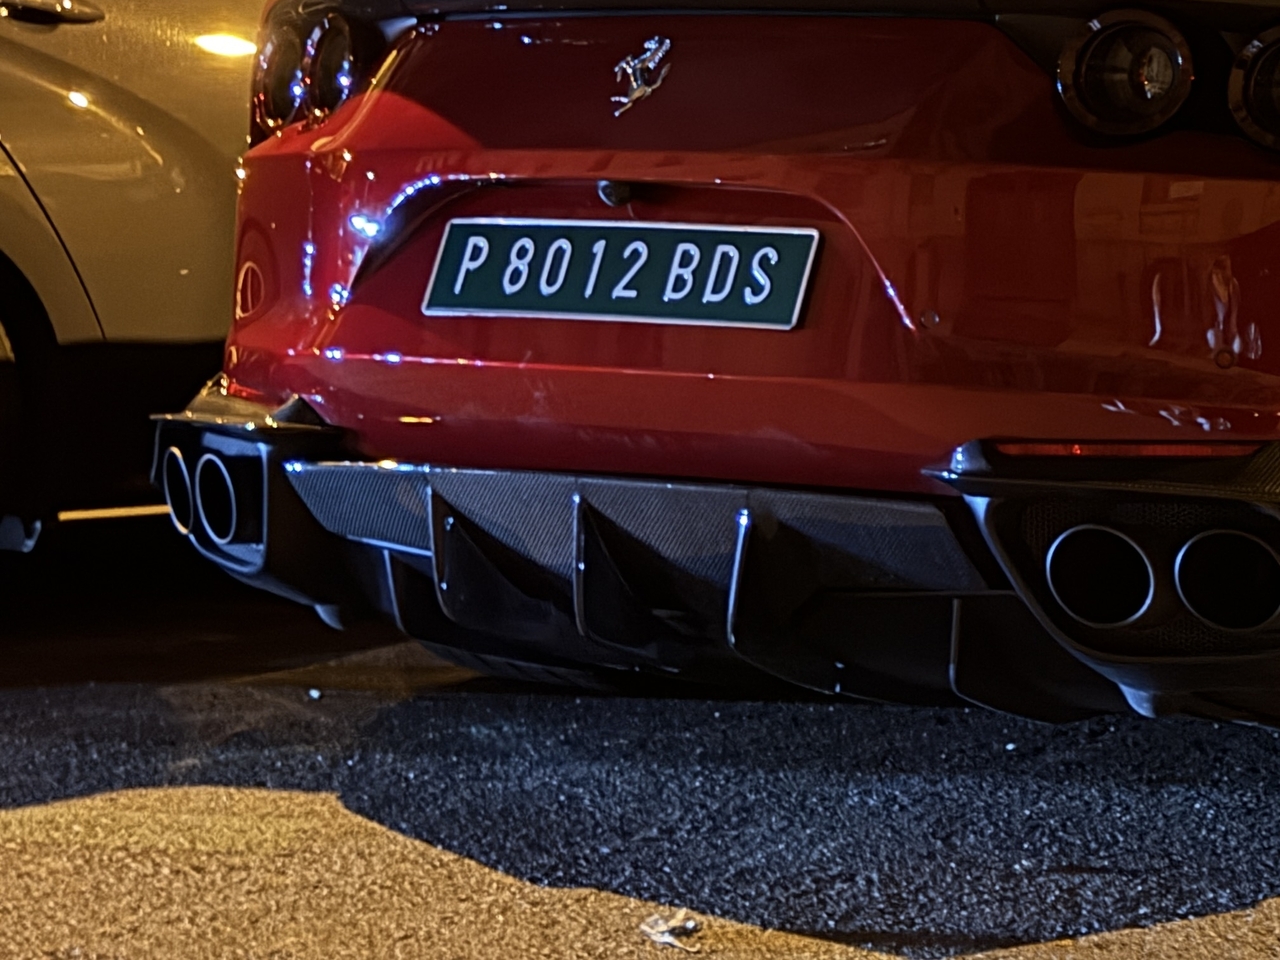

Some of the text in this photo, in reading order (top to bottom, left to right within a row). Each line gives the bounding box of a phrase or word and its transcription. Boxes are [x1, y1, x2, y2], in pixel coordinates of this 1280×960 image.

[453, 235, 780, 306] P 8012 BDS
